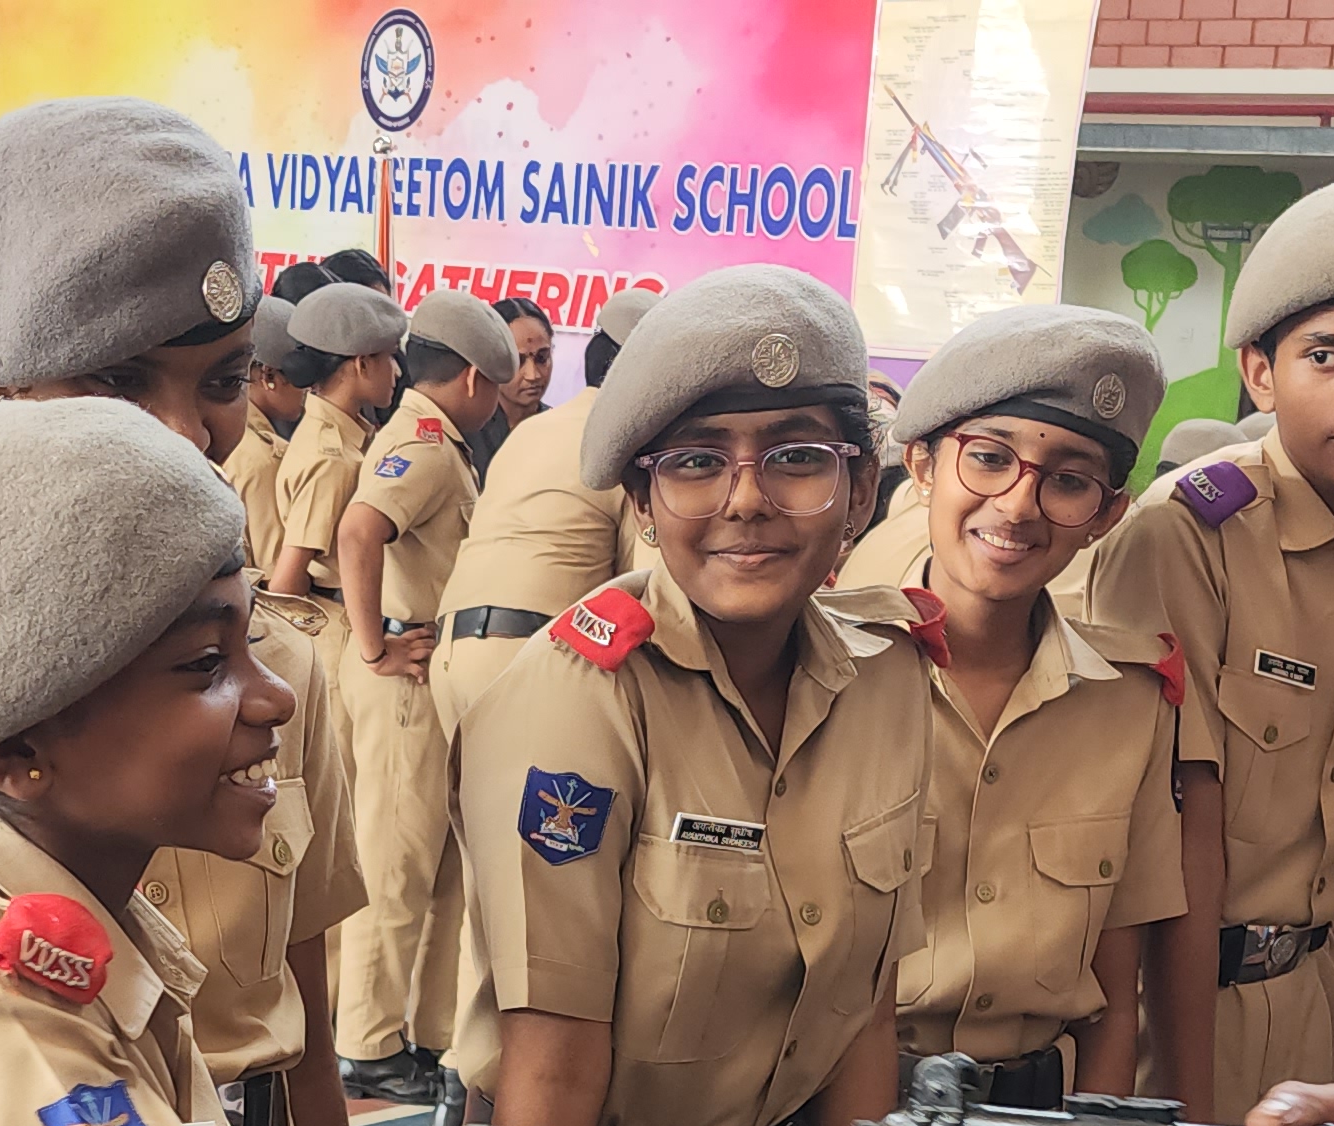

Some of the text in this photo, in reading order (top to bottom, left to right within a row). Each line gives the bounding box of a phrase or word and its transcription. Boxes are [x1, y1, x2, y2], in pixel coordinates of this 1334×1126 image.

[520, 159, 660, 229] SAINIK
[671, 163, 857, 239] SCHOOL
[395, 261, 664, 328] ATHERIN
[570, 601, 617, 646] VVSS
[19, 929, 95, 989] VVSS
